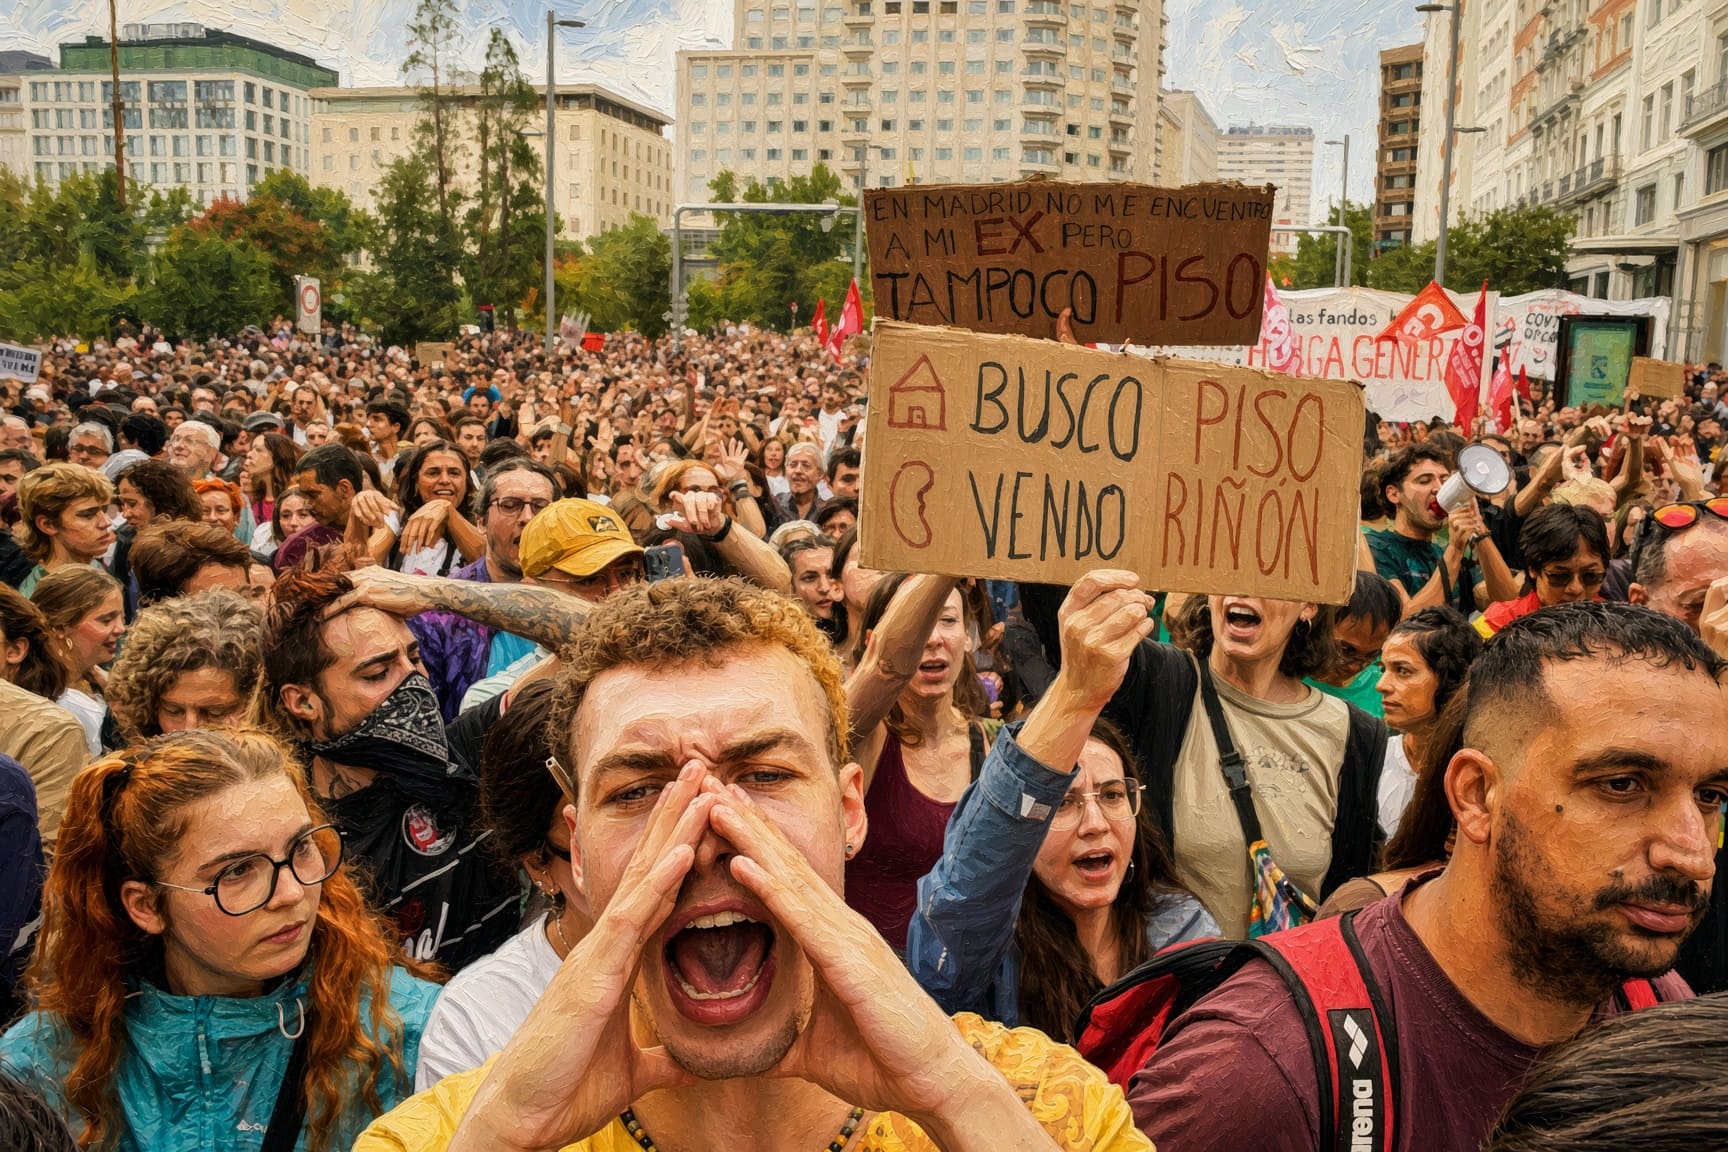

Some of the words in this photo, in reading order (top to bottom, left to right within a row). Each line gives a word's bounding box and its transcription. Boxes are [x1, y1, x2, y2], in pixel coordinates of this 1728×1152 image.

[873, 195, 909, 221] EN
[924, 191, 1032, 218] MADRID
[1047, 192, 1082, 216] NO
[1095, 194, 1137, 217] ME
[885, 232, 910, 260] A
[924, 228, 956, 256] MI
[1062, 222, 1133, 249] PERO
[876, 267, 1097, 325] TAMPOCO
[1115, 250, 1261, 324] PISO
[1353, 334, 1445, 381] GENER
[969, 361, 1144, 462] BUSCO
[1194, 379, 1325, 483] PISO
[968, 469, 1126, 562] VENDO
[1161, 471, 1321, 586] RIÑÓN
